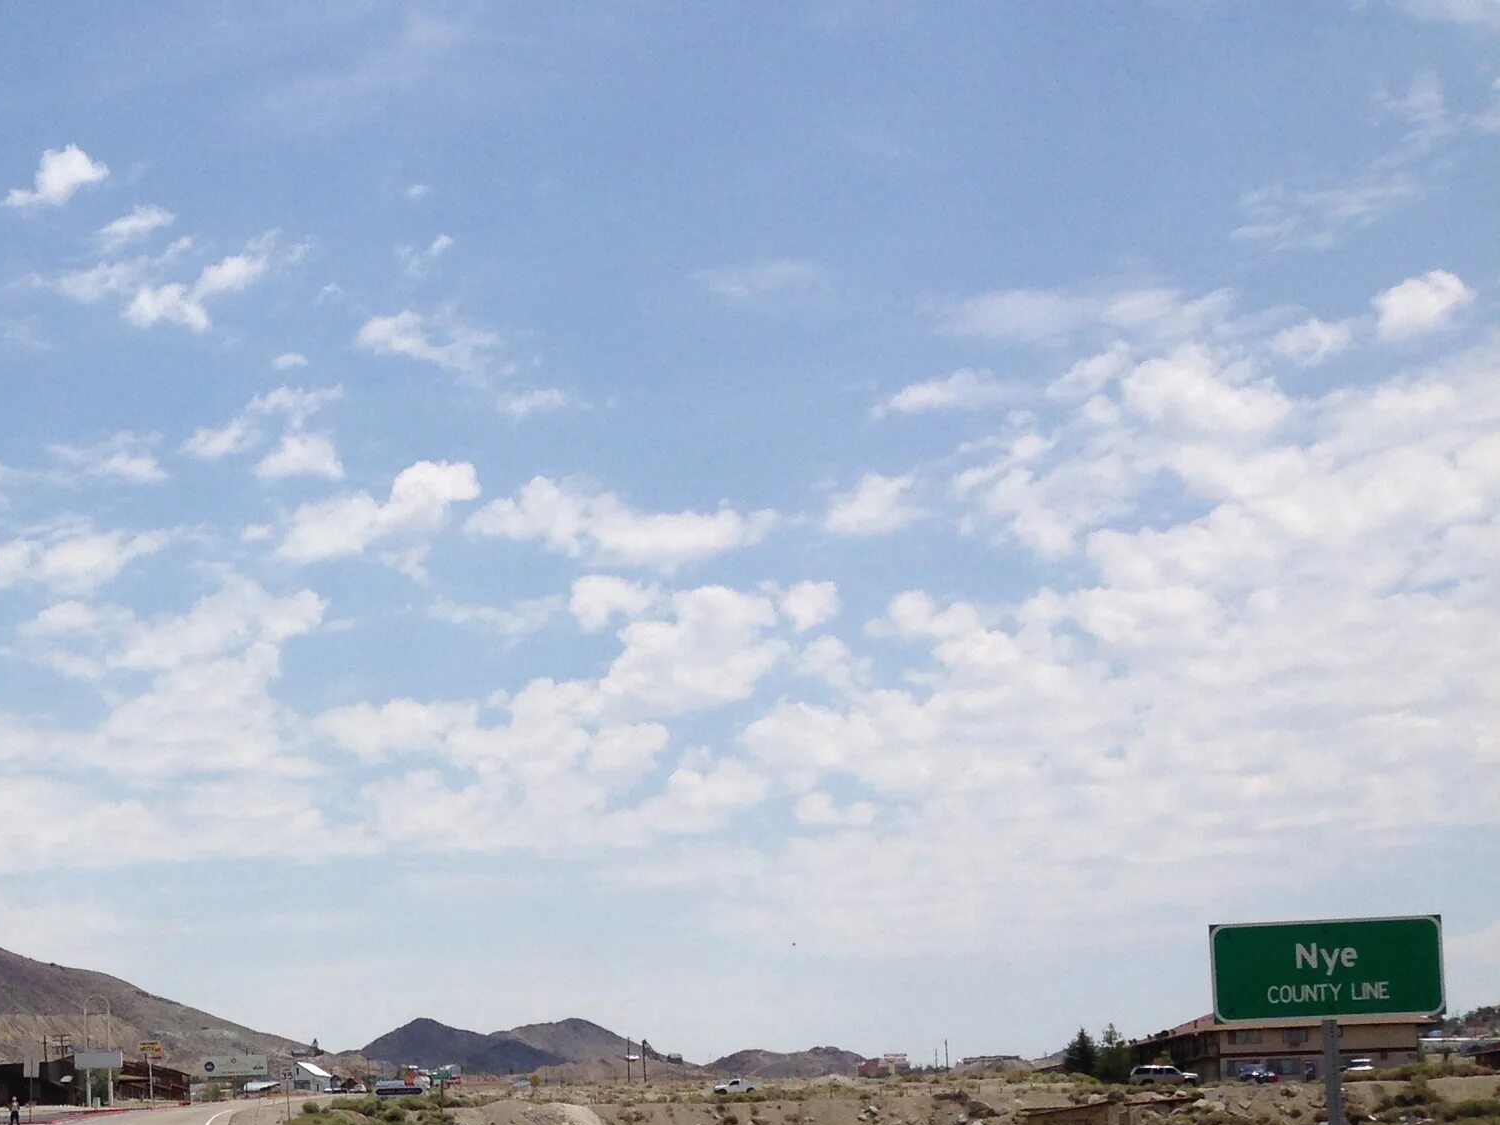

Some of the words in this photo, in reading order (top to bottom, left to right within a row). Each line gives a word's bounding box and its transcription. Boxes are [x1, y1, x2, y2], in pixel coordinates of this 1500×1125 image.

[1295, 942, 1358, 976] Nye
[1267, 983, 1342, 1004] COUNTY
[1351, 981, 1390, 1001] LINE
